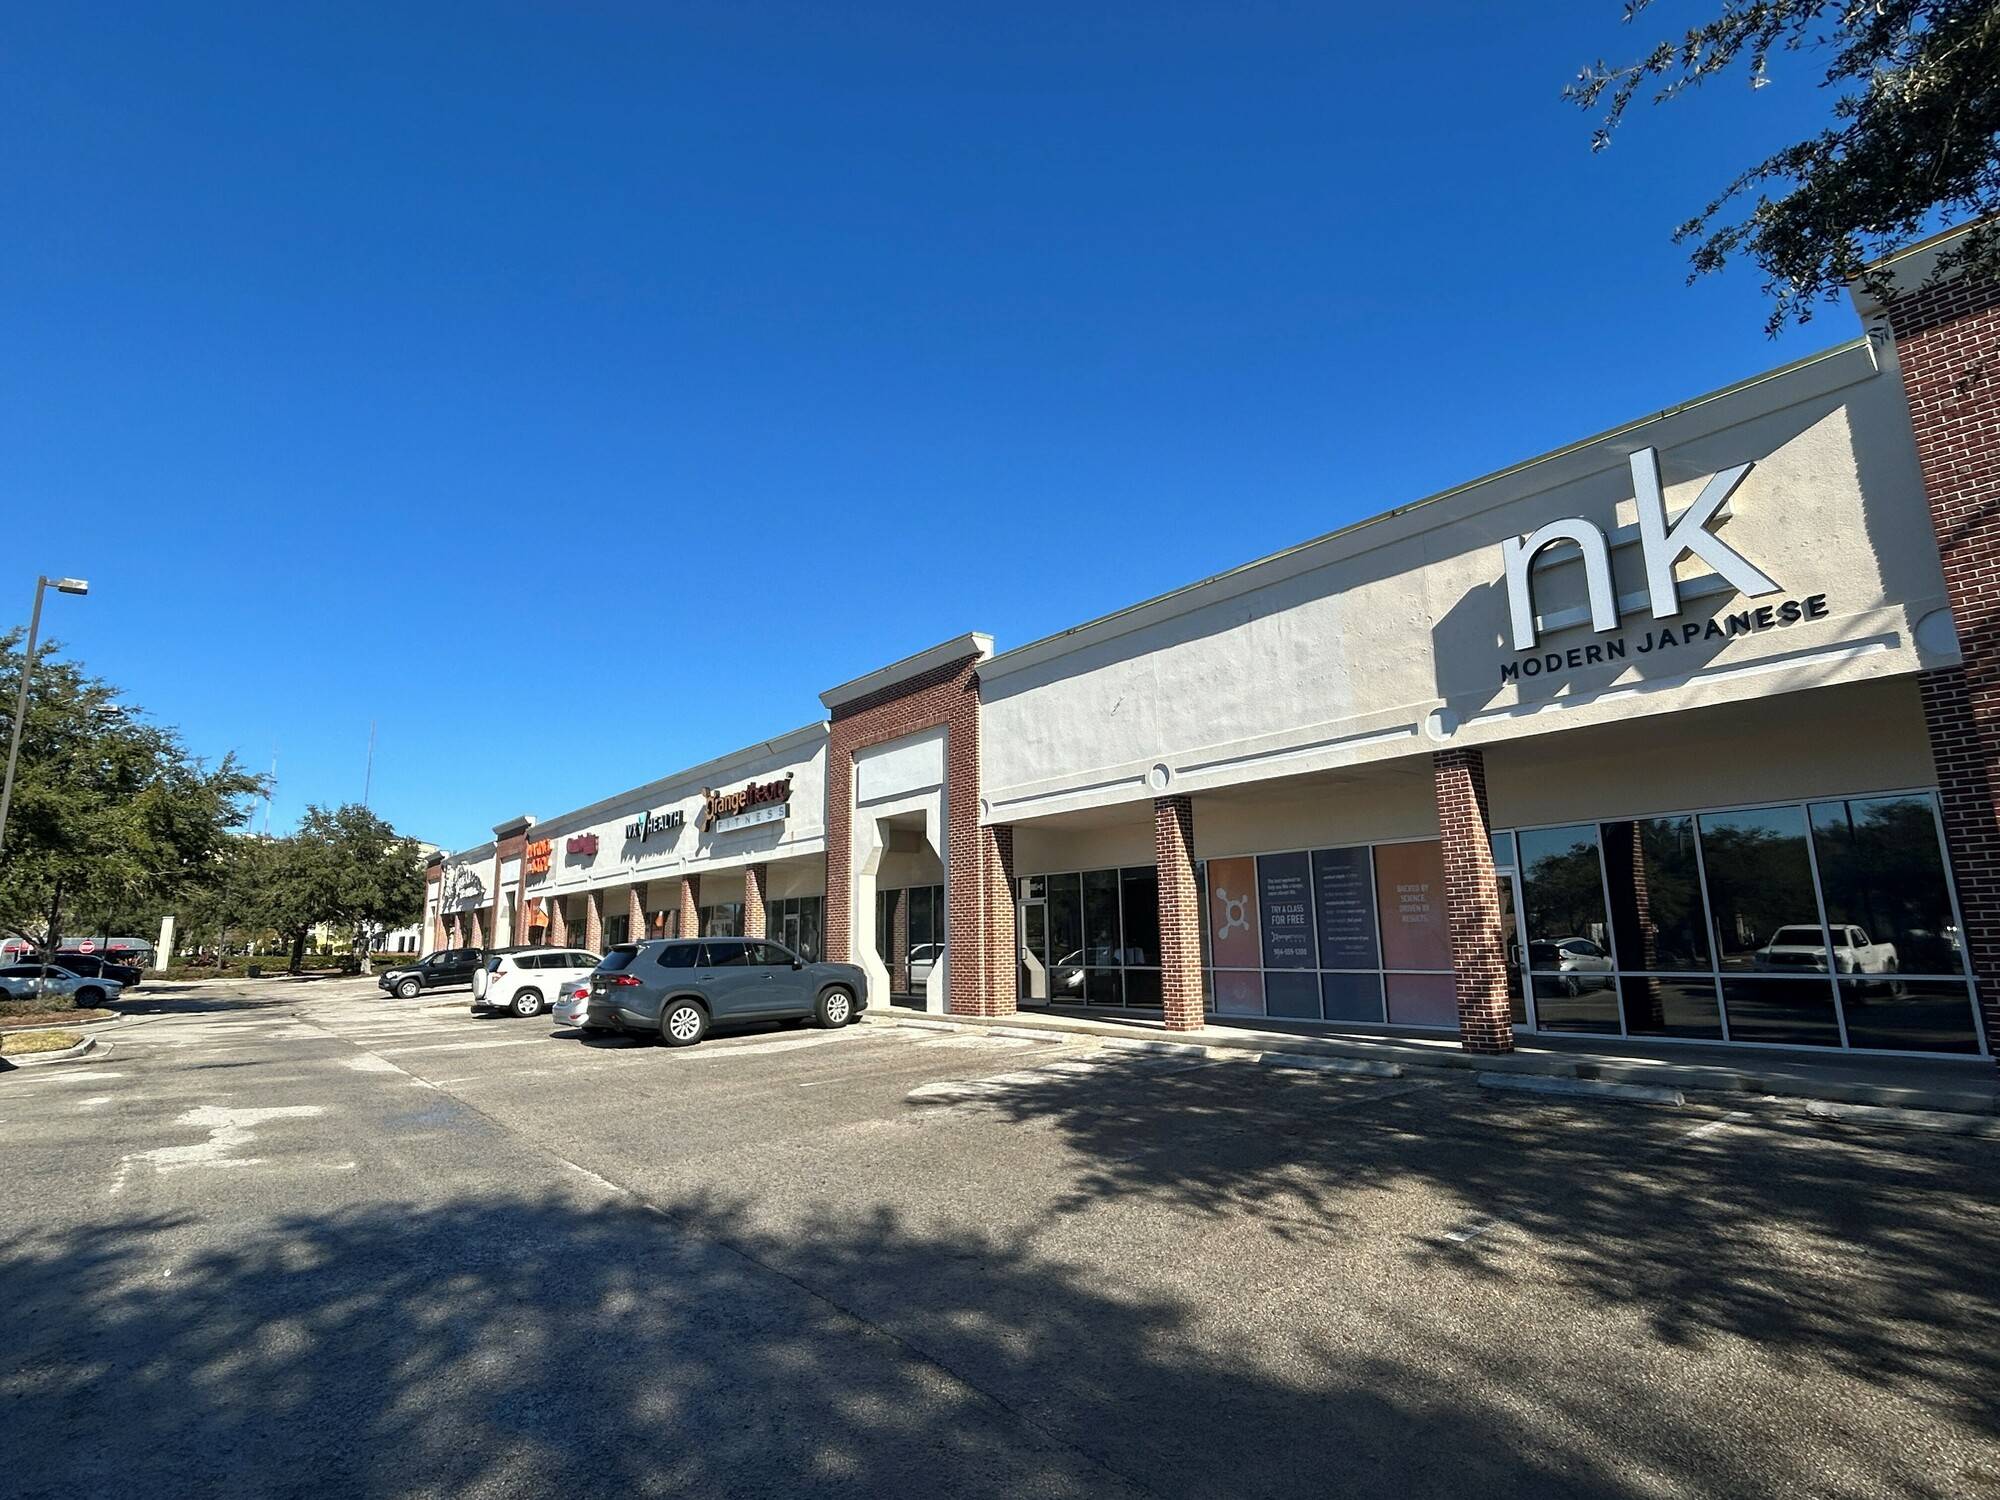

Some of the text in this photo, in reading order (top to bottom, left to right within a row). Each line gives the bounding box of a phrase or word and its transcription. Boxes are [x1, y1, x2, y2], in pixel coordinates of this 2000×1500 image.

[1502, 445, 1784, 651] nk
[1500, 593, 1829, 682] MODERN JAPANESE
[647, 811, 683, 833] HEALTH
[718, 806, 785, 830] FITNESS
[1271, 914, 1305, 925] FOR FREE
[1287, 904, 1304, 913] CLASS
